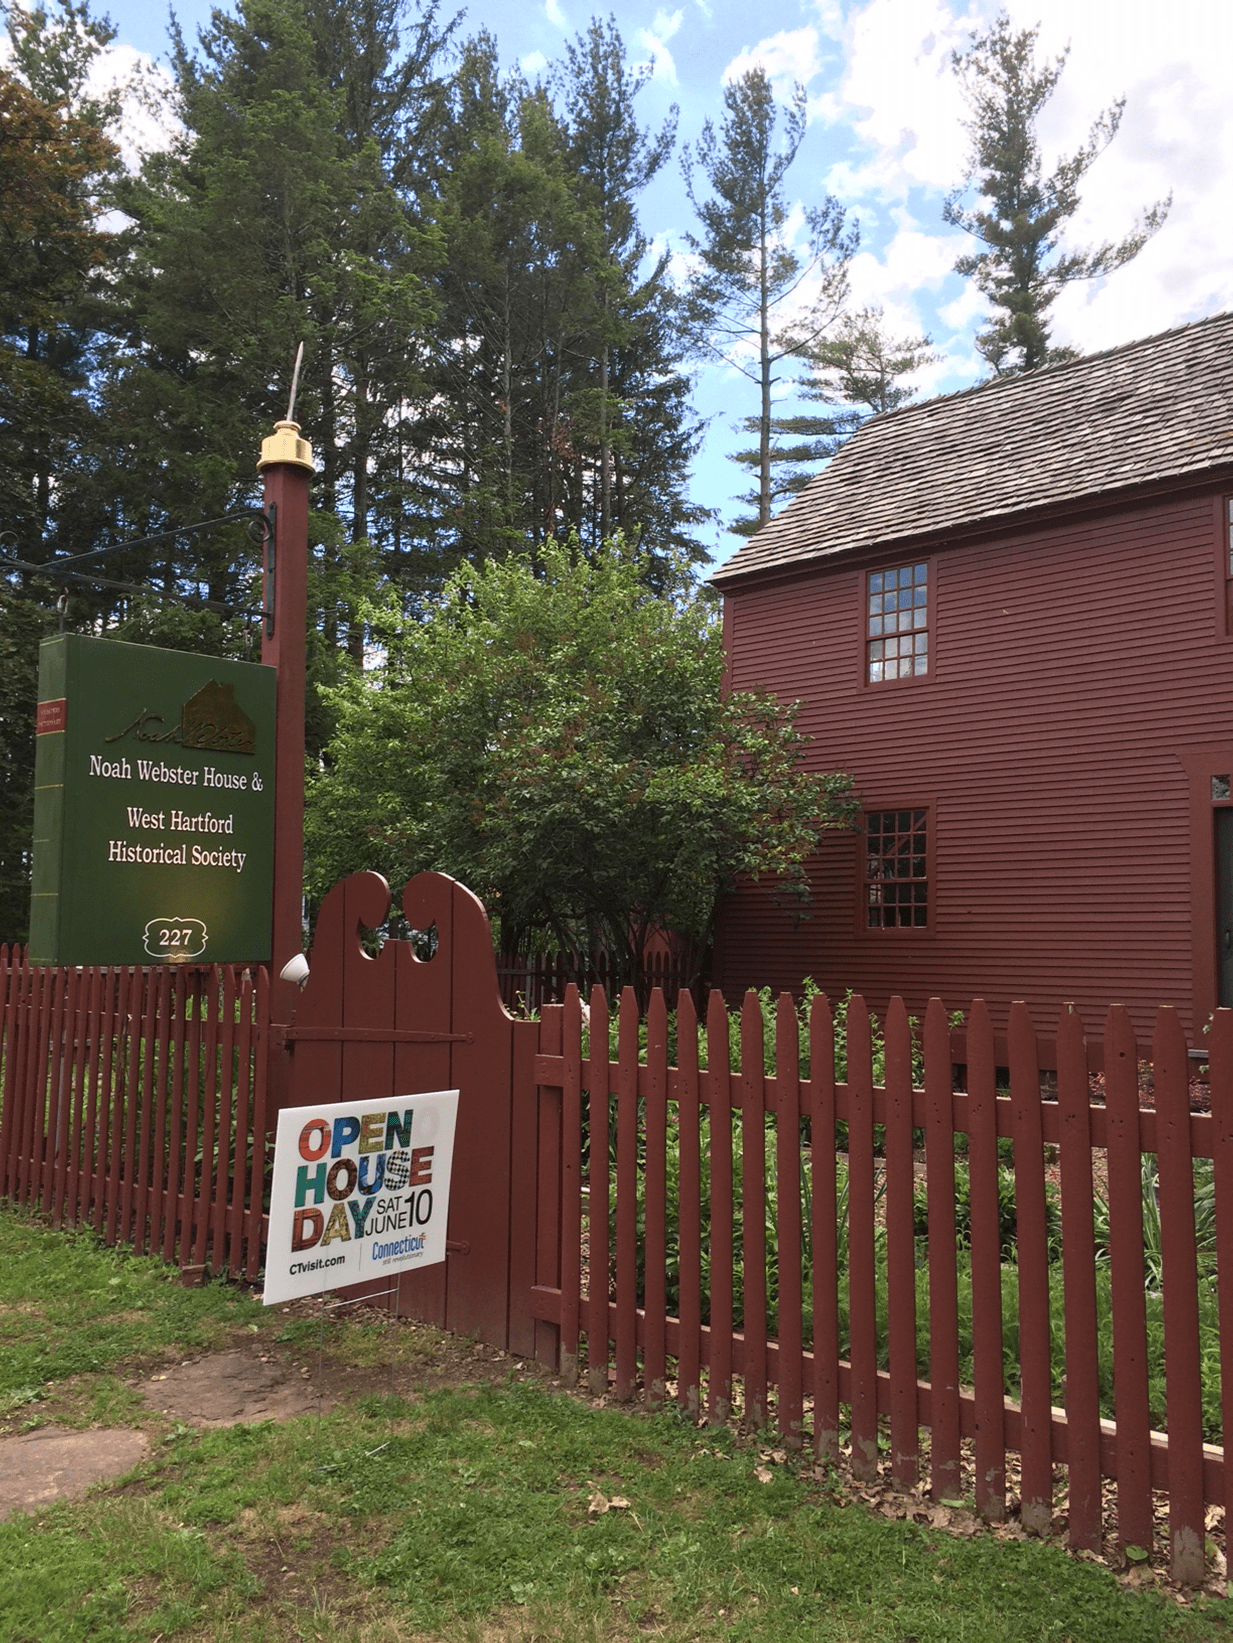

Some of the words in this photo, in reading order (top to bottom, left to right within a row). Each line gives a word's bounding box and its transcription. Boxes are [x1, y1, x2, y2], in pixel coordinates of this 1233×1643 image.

[89, 755, 132, 780] Noah
[137, 759, 199, 786] Webster
[203, 767, 247, 790] House
[251, 772, 263, 791] &
[127, 806, 165, 830] West
[170, 810, 233, 834] Hartford
[108, 840, 187, 865] Historical
[191, 845, 246, 872] Society
[159, 929, 192, 946] 227
[298, 1109, 414, 1162] OPEN
[295, 1145, 435, 1208] HOUSE
[376, 1196, 402, 1214] SAT
[404, 1189, 433, 1227] 10
[291, 1196, 377, 1253] DAY
[365, 1211, 407, 1236] JUNE
[372, 1235, 424, 1261] Connecticut
[289, 1255, 346, 1276] CTvisit.com
